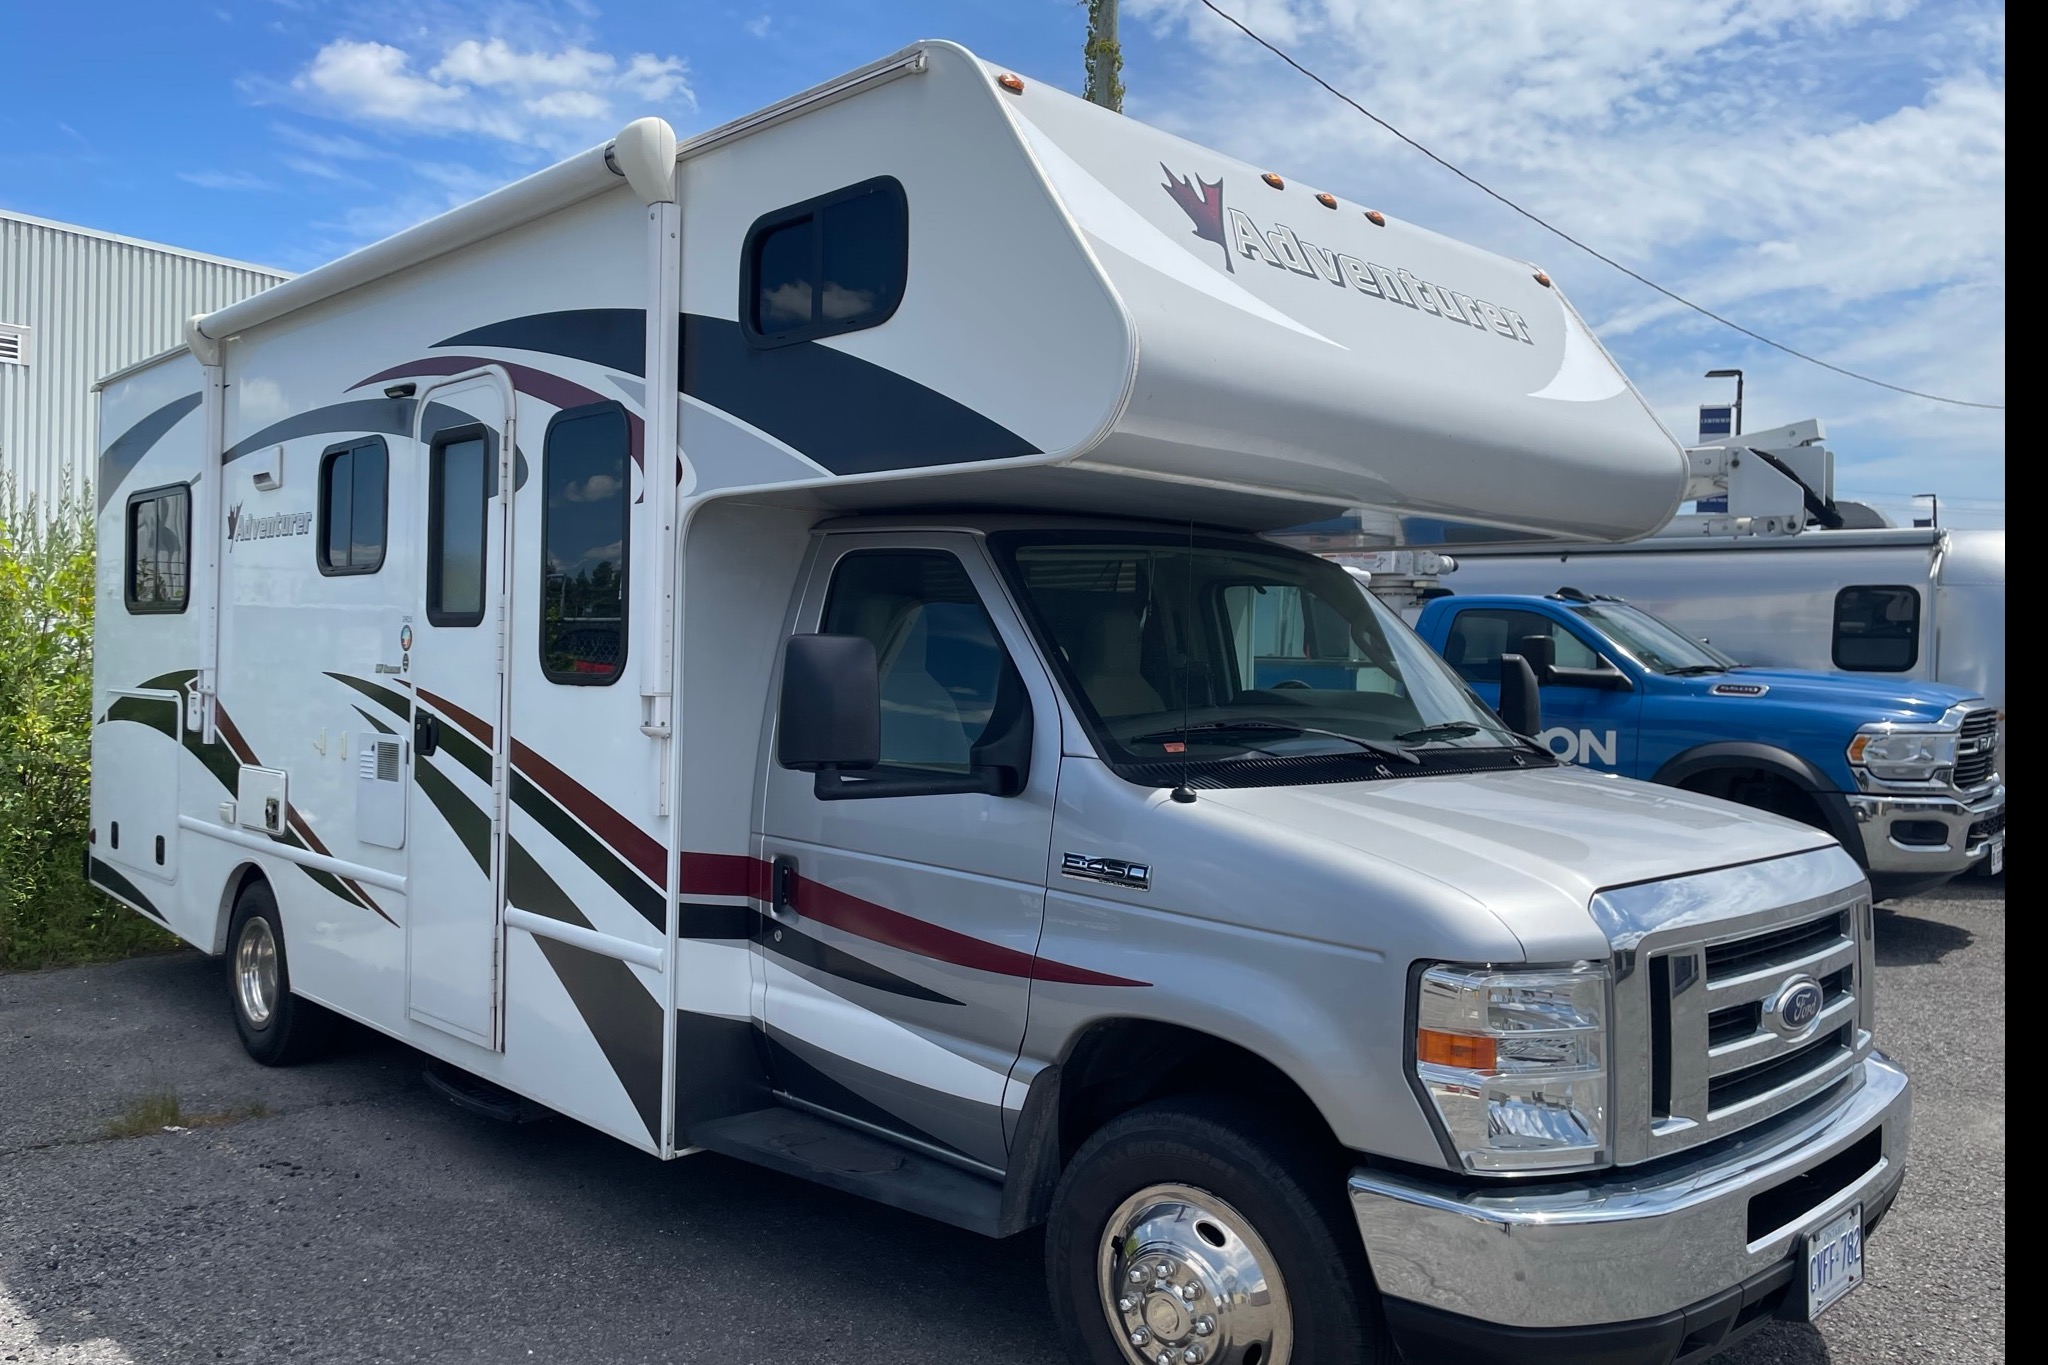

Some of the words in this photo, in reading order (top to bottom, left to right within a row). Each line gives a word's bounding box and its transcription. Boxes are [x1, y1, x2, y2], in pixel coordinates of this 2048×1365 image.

[1228, 206, 1534, 345] Adventurer
[235, 511, 312, 542] Adventurer
[1534, 726, 1617, 766] ON
[1793, 992, 1817, 1021] Ford
